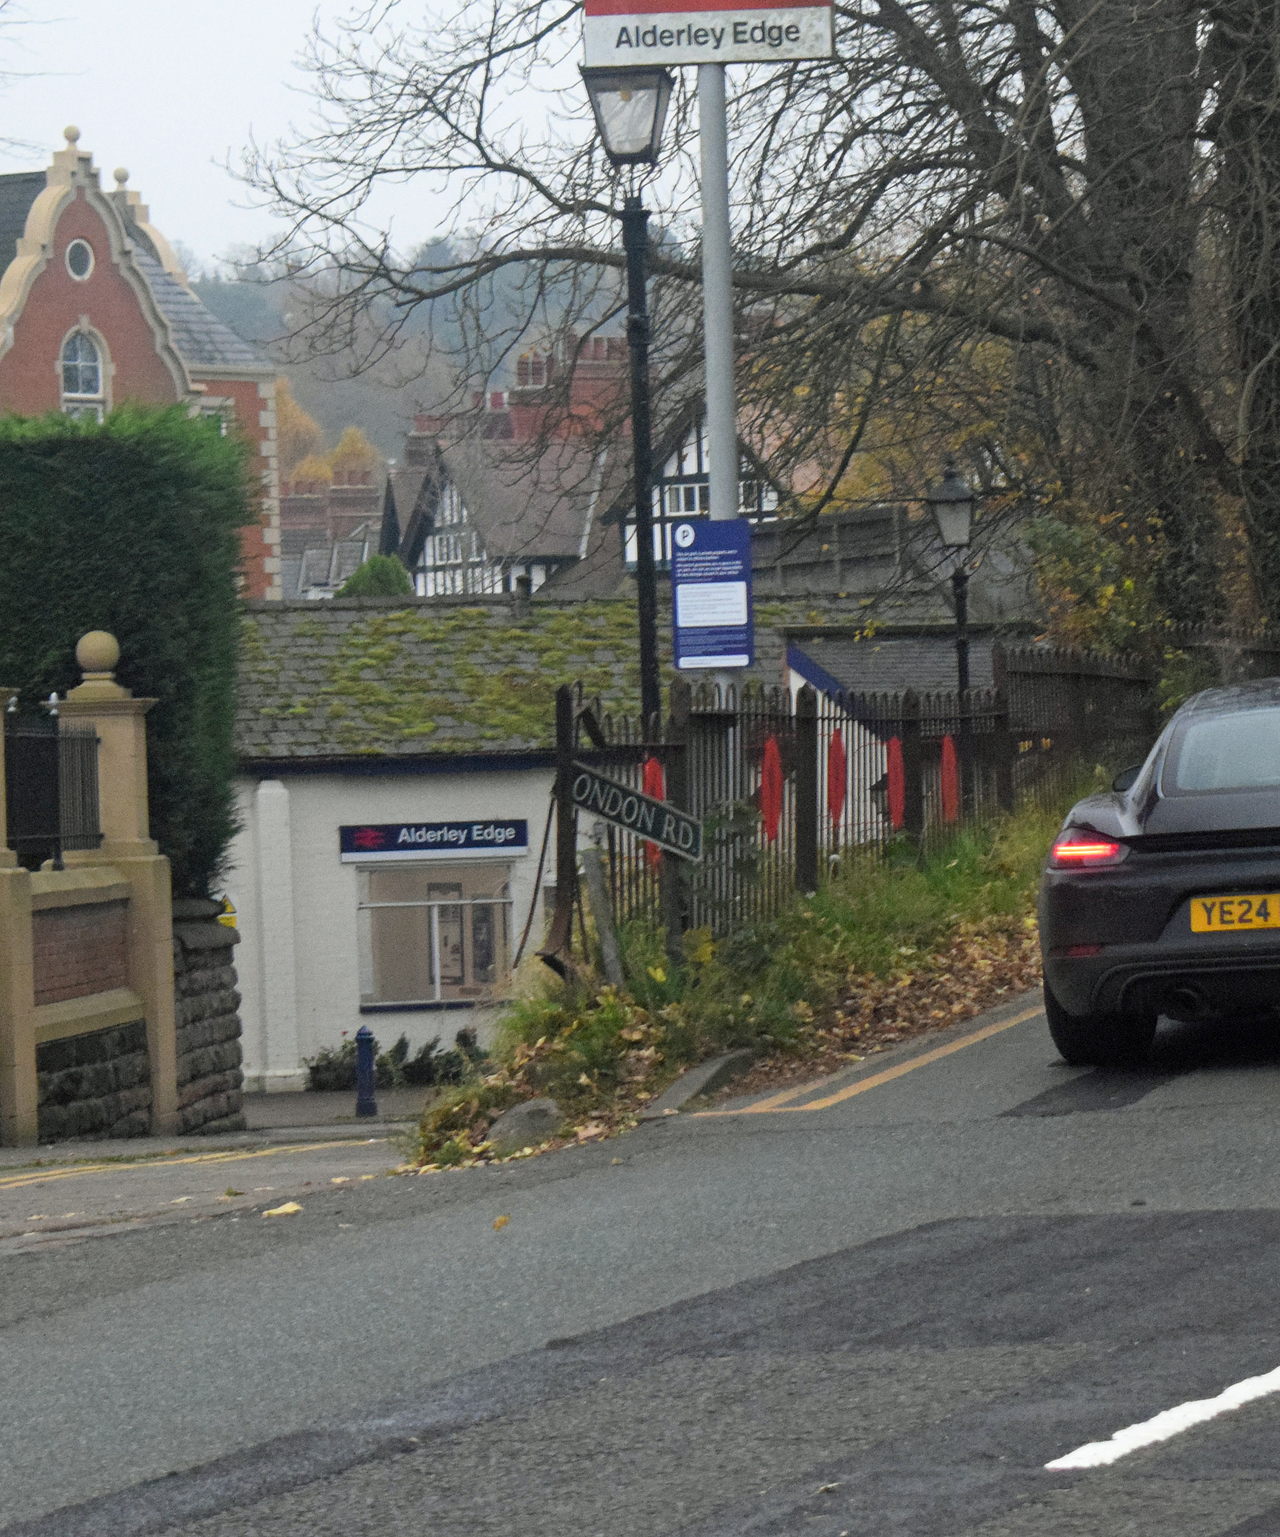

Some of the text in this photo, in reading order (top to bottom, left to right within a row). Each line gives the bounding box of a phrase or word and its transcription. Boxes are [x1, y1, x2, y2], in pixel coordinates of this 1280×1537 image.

[615, 20, 801, 50] Alderley Edge
[572, 773, 656, 832] ONDON
[397, 824, 516, 844] Alderley Edge
[1202, 898, 1270, 925] YE24
